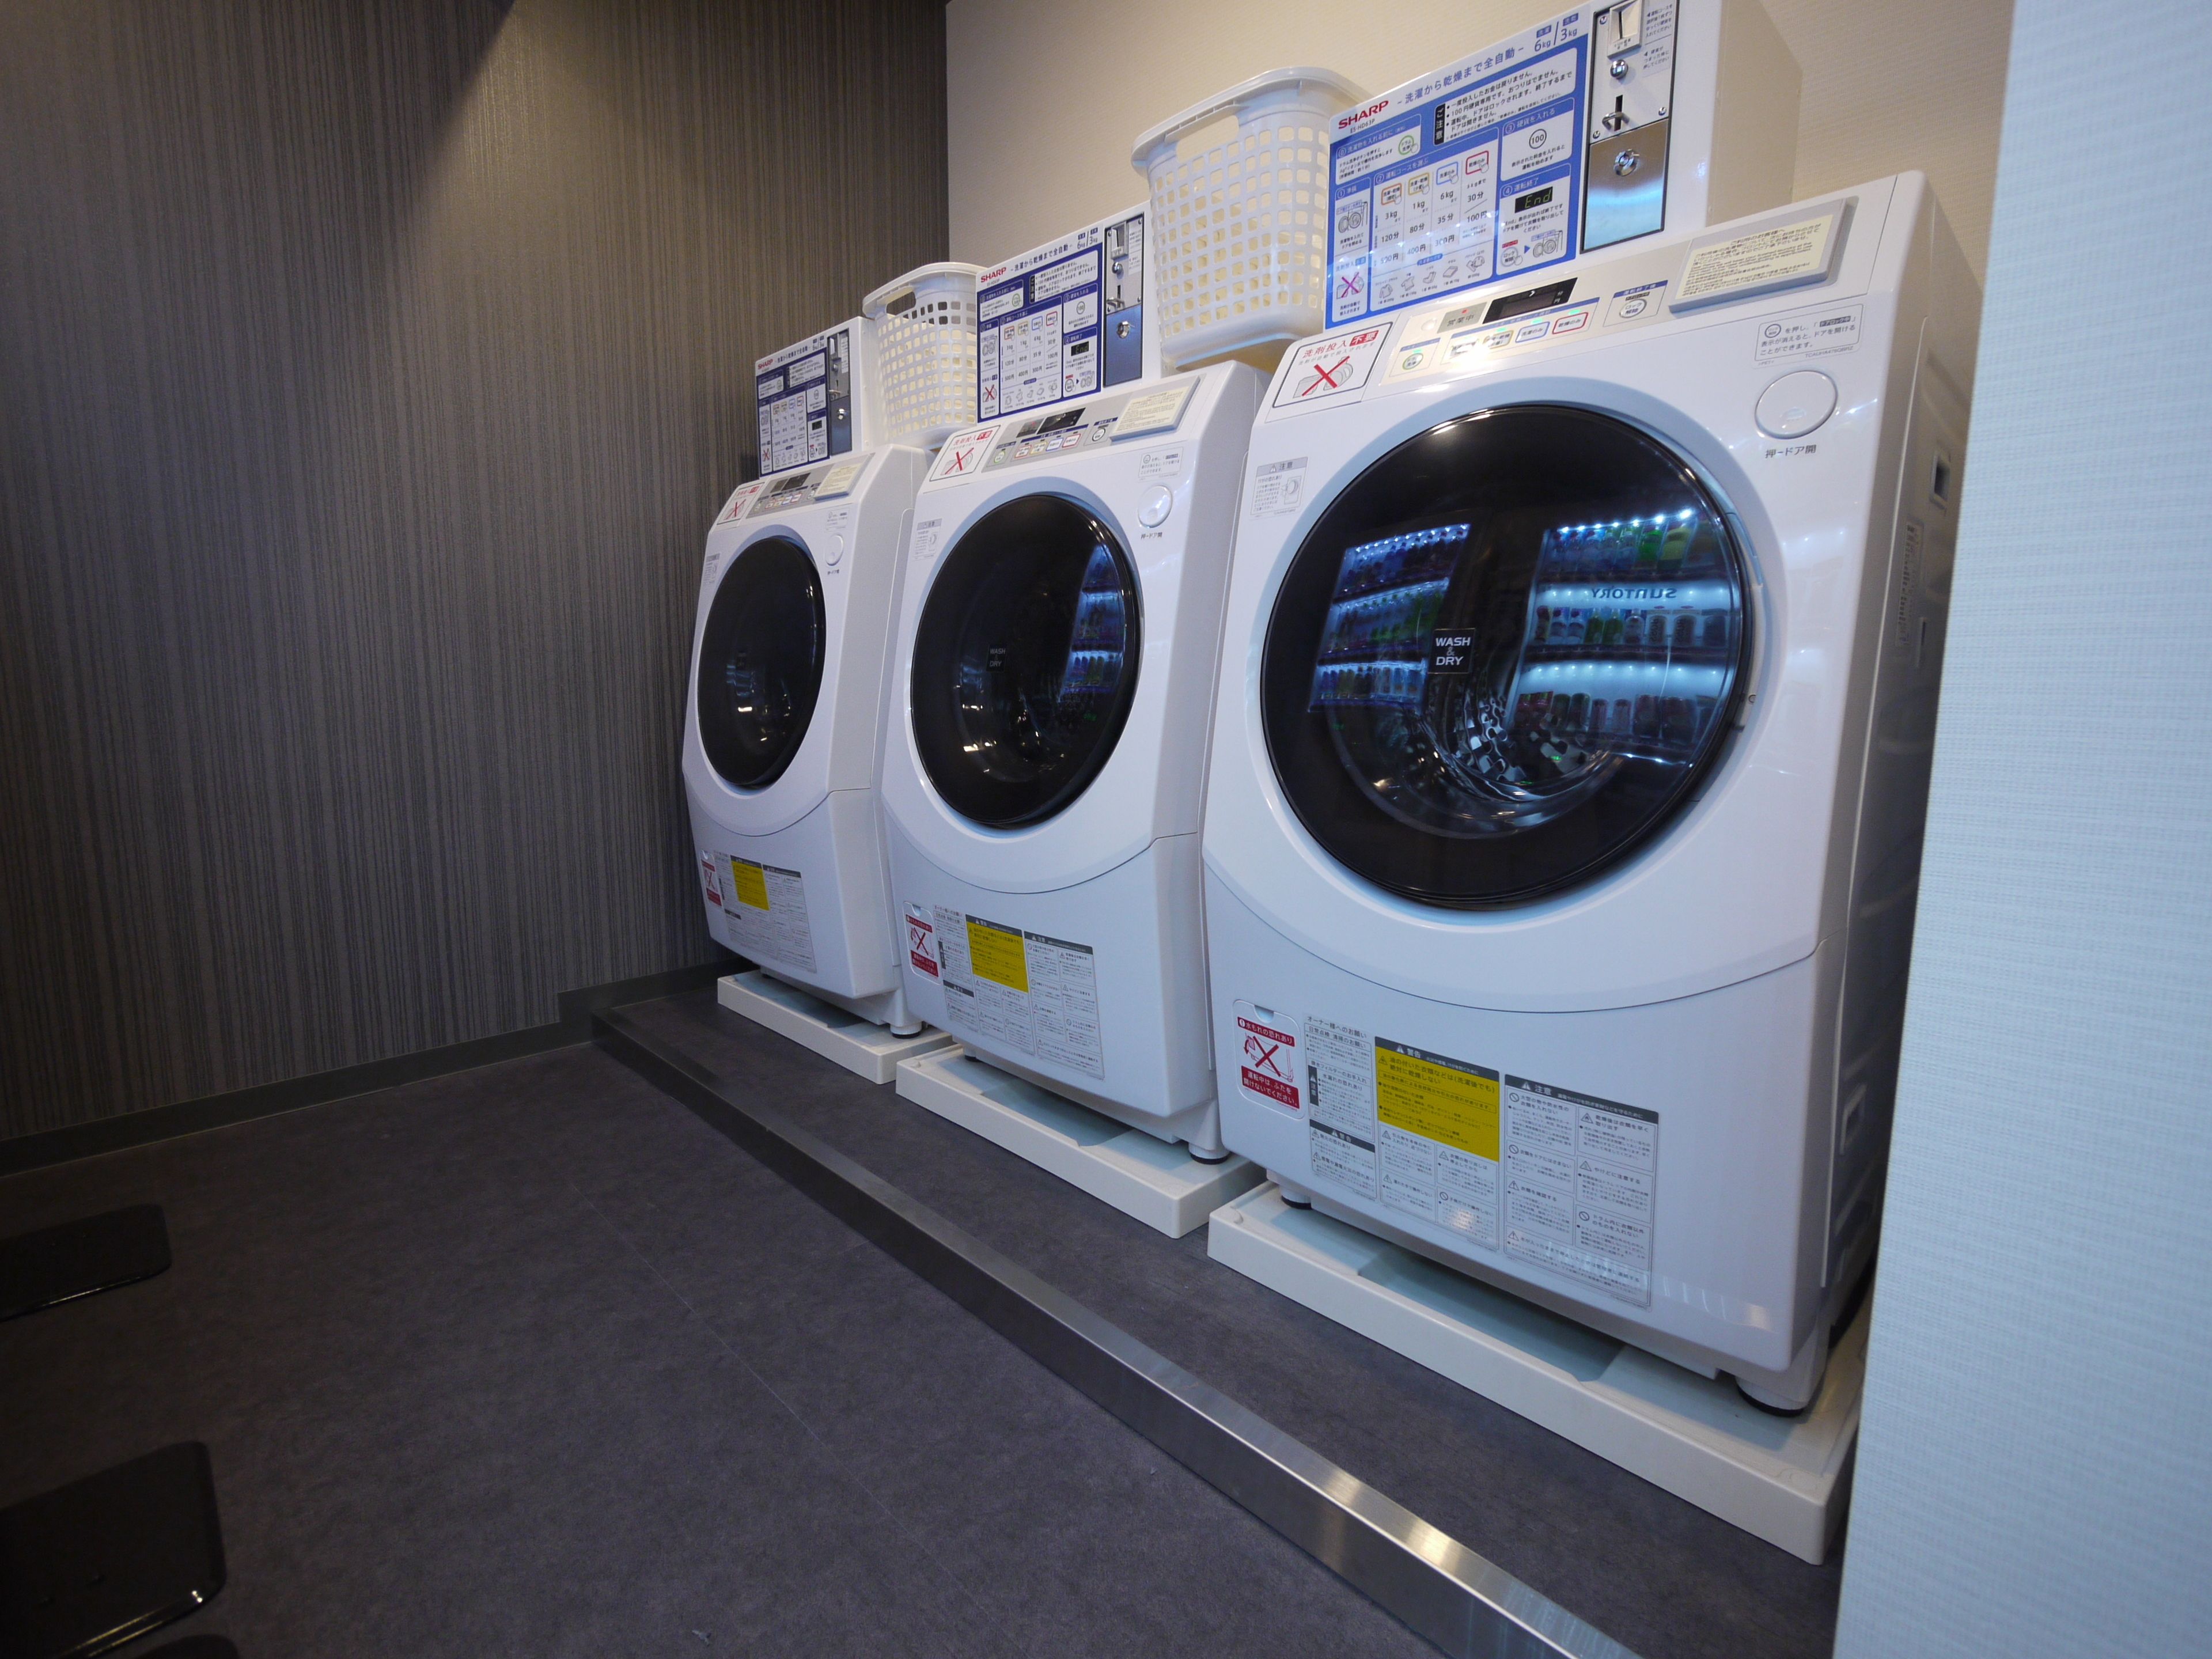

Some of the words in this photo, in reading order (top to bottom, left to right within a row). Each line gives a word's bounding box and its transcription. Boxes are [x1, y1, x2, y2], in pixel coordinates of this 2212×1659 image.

[1534, 34, 1551, 52] 6kg
[1560, 22, 1577, 41] 3kg
[1451, 69, 1532, 108] 一度投入したお金は戻りません。
[1338, 99, 1388, 130] SHARP
[1531, 133, 1544, 145] 100
[1467, 190, 1483, 203] 30分
[1525, 188, 1551, 209] End
[1437, 212, 1453, 225] 35分
[1467, 210, 1487, 224] 100円
[1410, 222, 1424, 234] 80分
[1381, 230, 1399, 243] 120分
[980, 266, 1006, 283] SHARP
[1302, 339, 1349, 358] 洗剤投入
[1760, 342, 1813, 356] ことができます。
[1435, 637, 1471, 646] WASH
[1446, 646, 1455, 656] &
[1435, 656, 1464, 665] DRY
[1245, 1021, 1292, 1045] 水もれの恐れあり
[1307, 1013, 1366, 1041] オーナー様へのお願い
[1407, 1048, 1421, 1058] 警告
[1243, 1077, 1297, 1105] 開けないでください。
[1535, 1084, 1551, 1096] 注意
